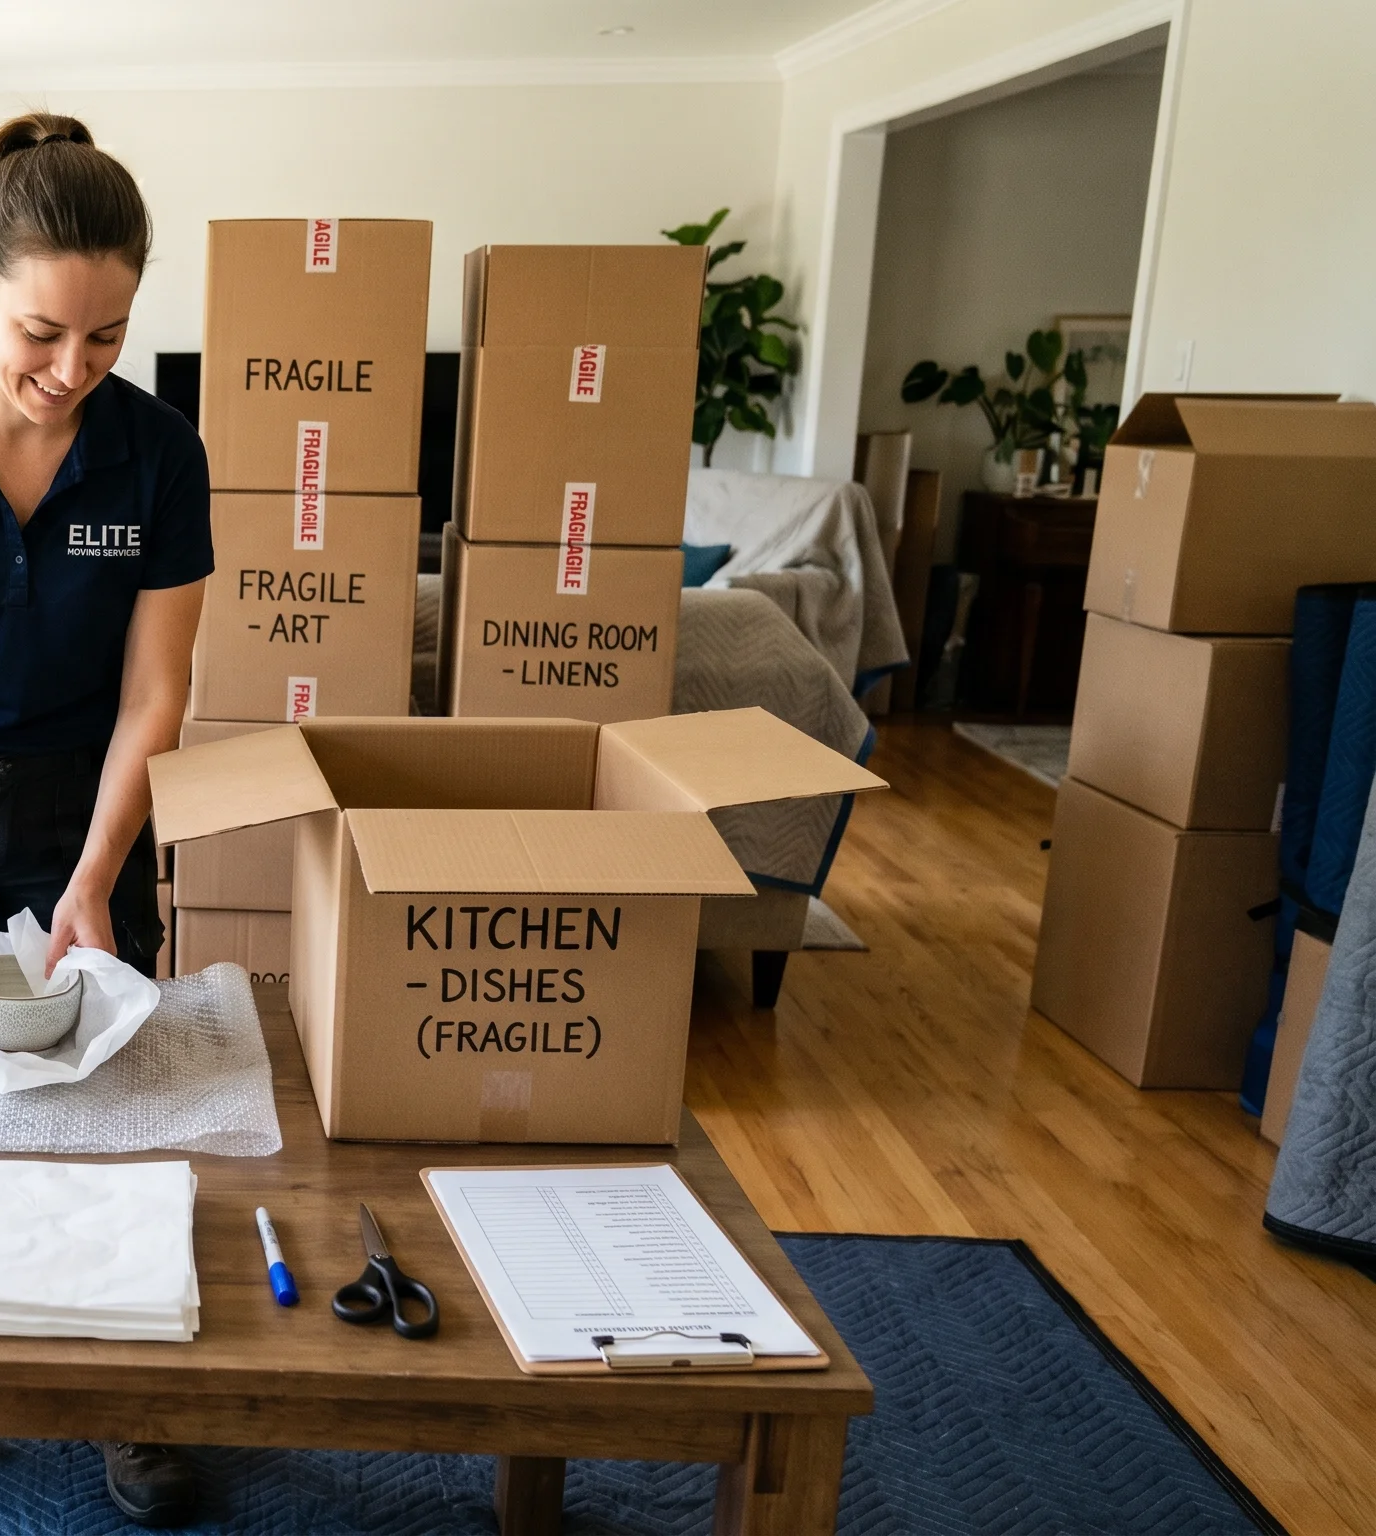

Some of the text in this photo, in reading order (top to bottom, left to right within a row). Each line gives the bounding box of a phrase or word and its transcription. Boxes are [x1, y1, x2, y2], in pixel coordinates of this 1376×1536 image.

[313, 220, 331, 265] AGILE
[246, 359, 373, 392] FRAGILE
[576, 346, 597, 395] AGILE
[302, 429, 321, 490] FRAGILE
[68, 548, 100, 556] MOVING
[69, 525, 140, 546] ELITE
[240, 570, 365, 603] FRAGILE
[269, 614, 329, 643] ART
[484, 620, 657, 651] DINING ROOM
[522, 661, 618, 687] LINENS
[408, 905, 621, 950] KITCHEN
[442, 968, 584, 1003] DISHES
[418, 1015, 601, 1059] (FRAGILE)
